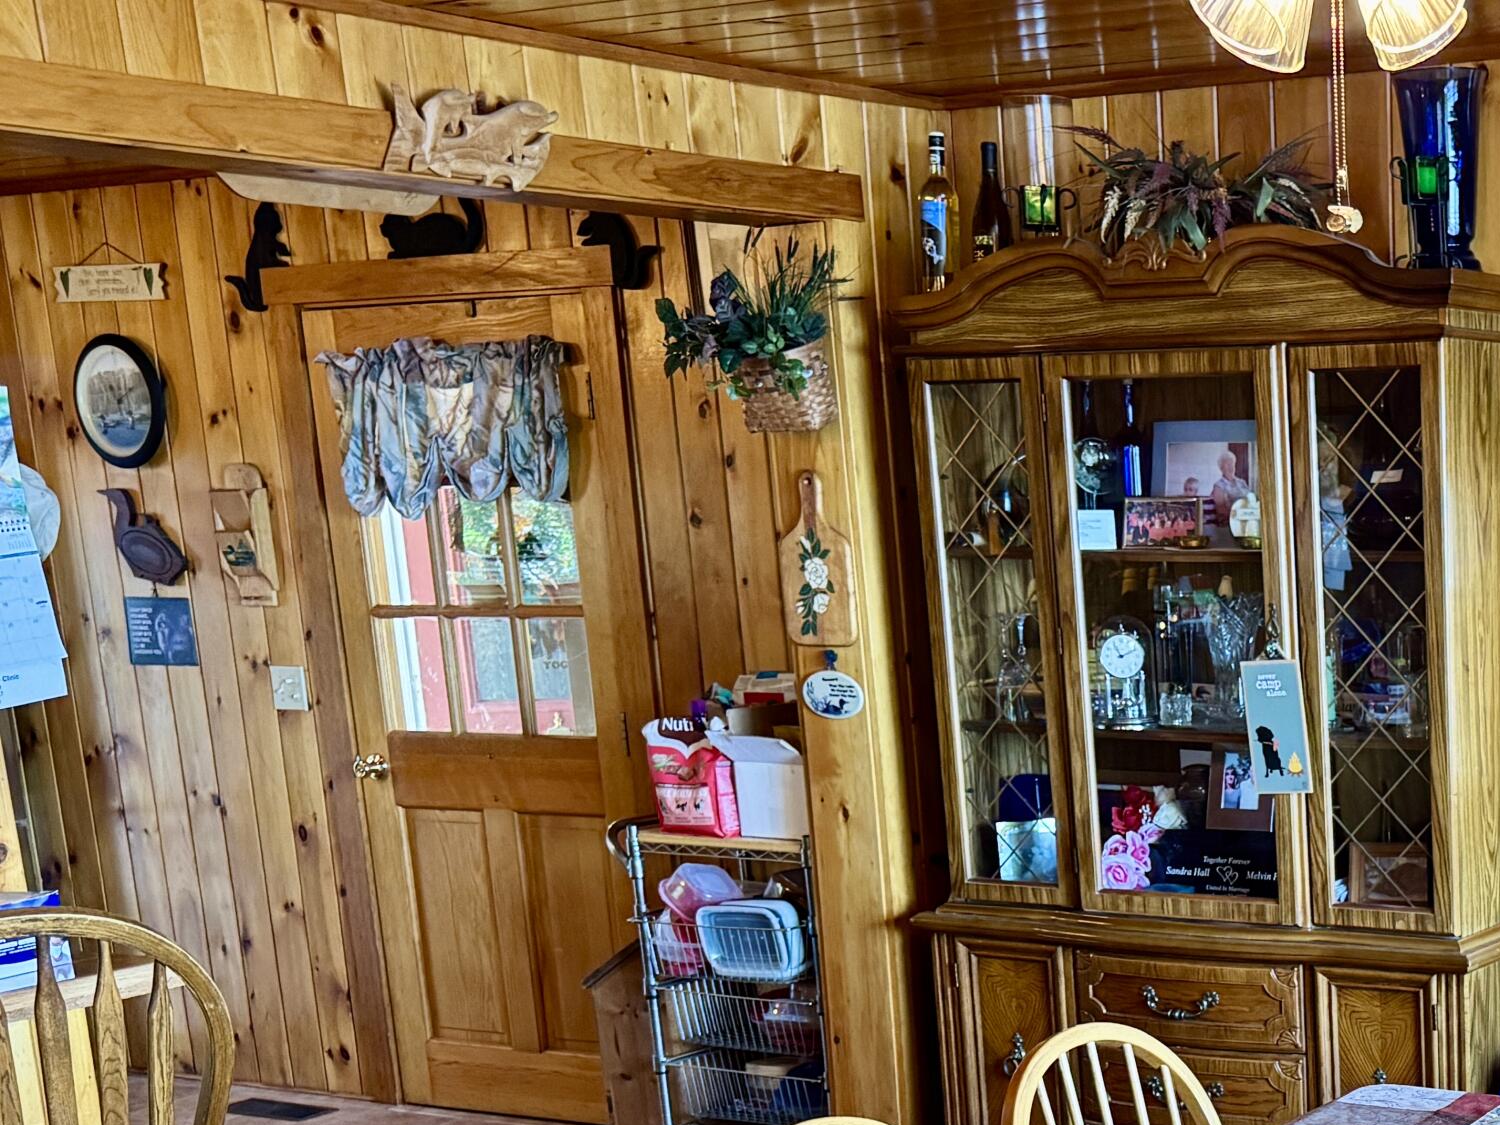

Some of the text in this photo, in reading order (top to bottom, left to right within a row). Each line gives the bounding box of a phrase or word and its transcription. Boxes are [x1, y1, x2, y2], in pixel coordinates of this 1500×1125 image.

[1256, 680, 1281, 691] camp
[1166, 866, 1211, 877] Sandra Hall
[1246, 870, 1272, 881] Melvin
